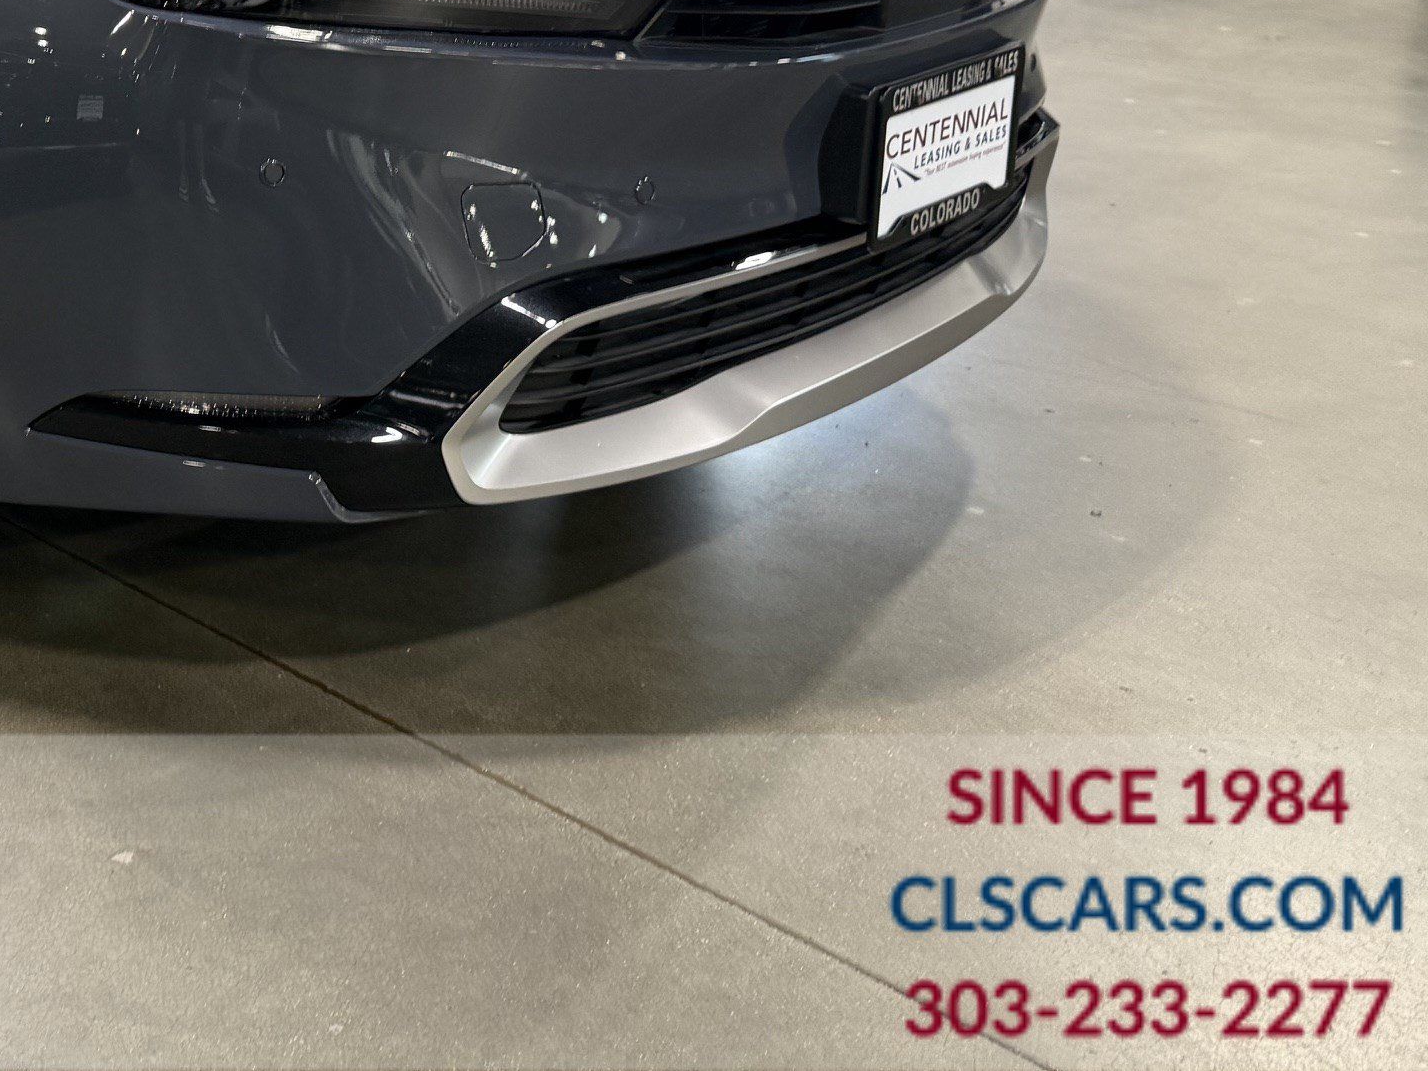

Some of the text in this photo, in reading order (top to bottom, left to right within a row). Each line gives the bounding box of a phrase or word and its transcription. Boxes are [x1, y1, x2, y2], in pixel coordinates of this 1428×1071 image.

[892, 50, 1019, 113] CENTENNIAL LEASING & SALES
[886, 98, 1008, 160] CENTENNIAL
[913, 140, 961, 169] LEASING
[964, 137, 971, 151] &
[974, 125, 1007, 147] SALES
[910, 188, 980, 236] COLORADO
